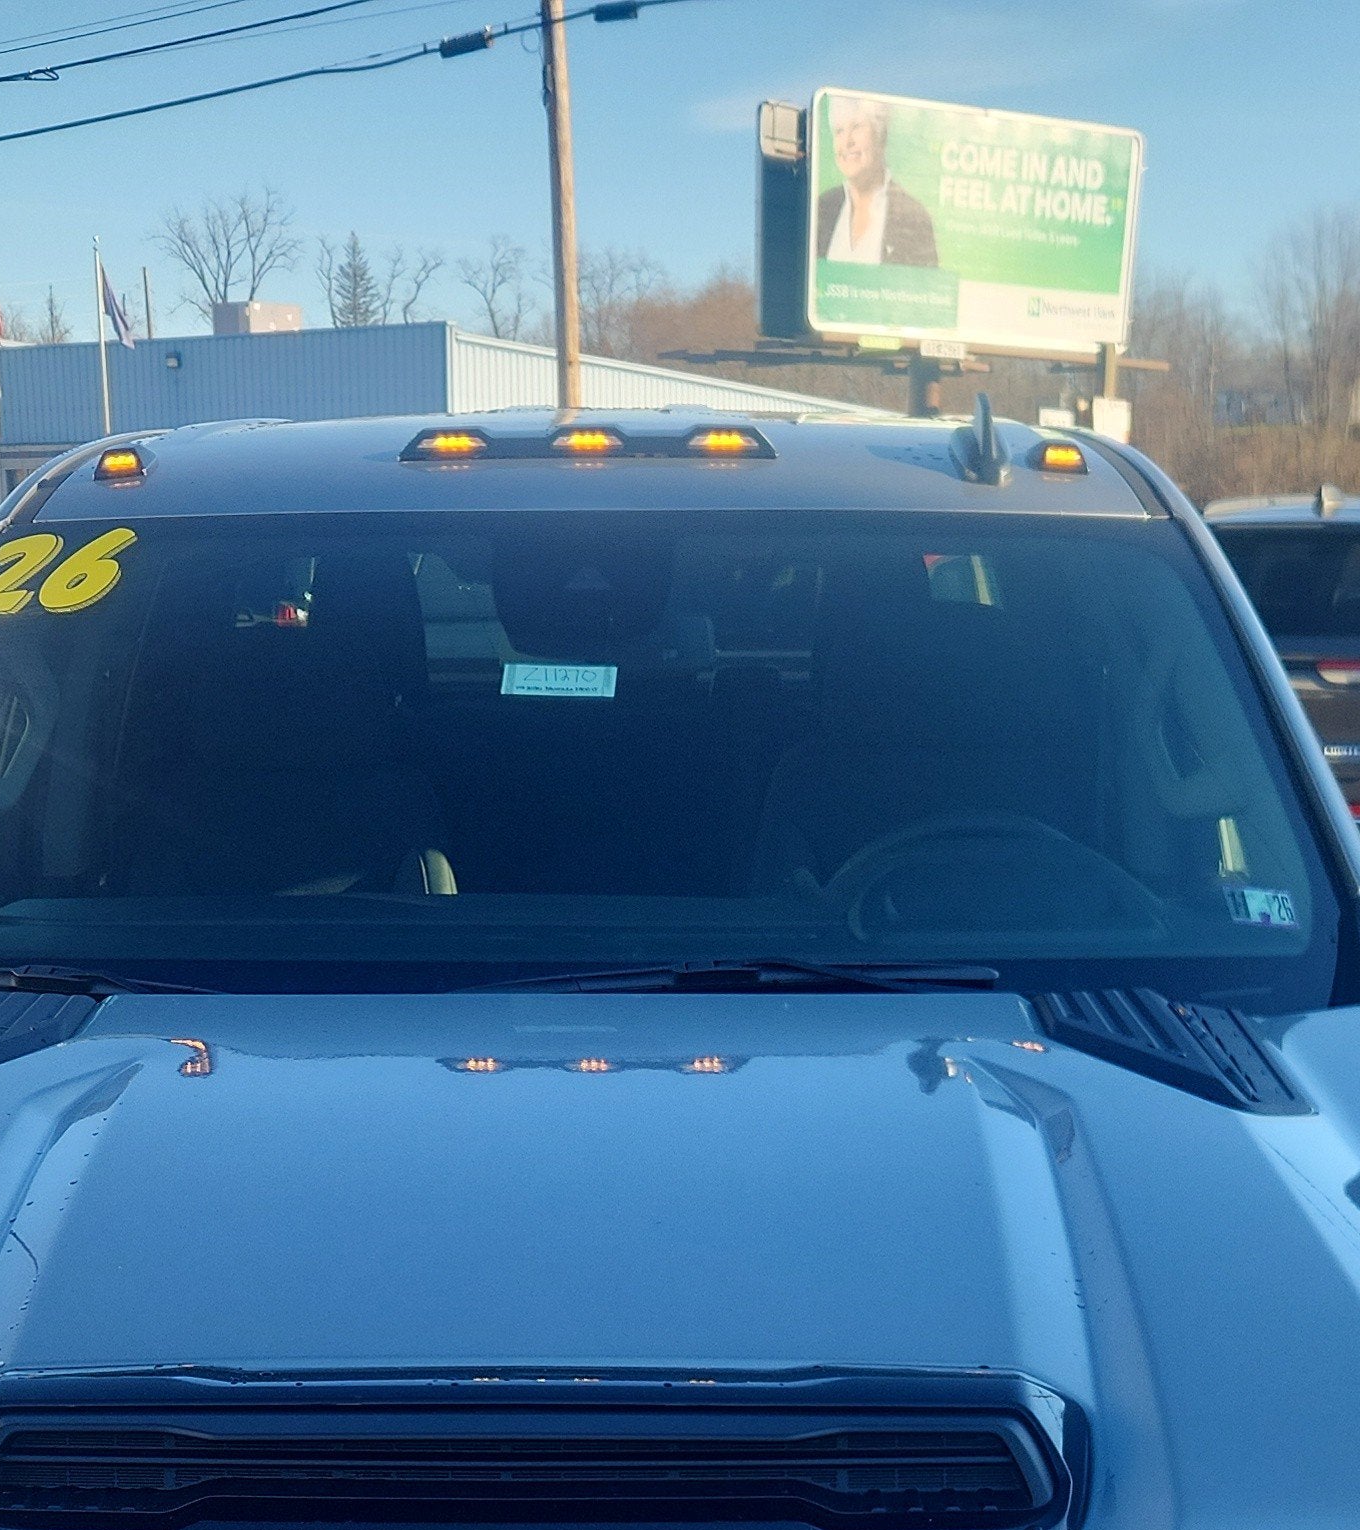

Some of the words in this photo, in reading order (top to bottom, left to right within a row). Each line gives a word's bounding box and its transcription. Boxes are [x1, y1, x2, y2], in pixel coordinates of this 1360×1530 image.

[940, 141, 1018, 180] COME
[1021, 150, 1048, 183] IN
[1051, 154, 1105, 191] AND
[939, 177, 997, 211] FEEL
[1000, 184, 1033, 215] AT
